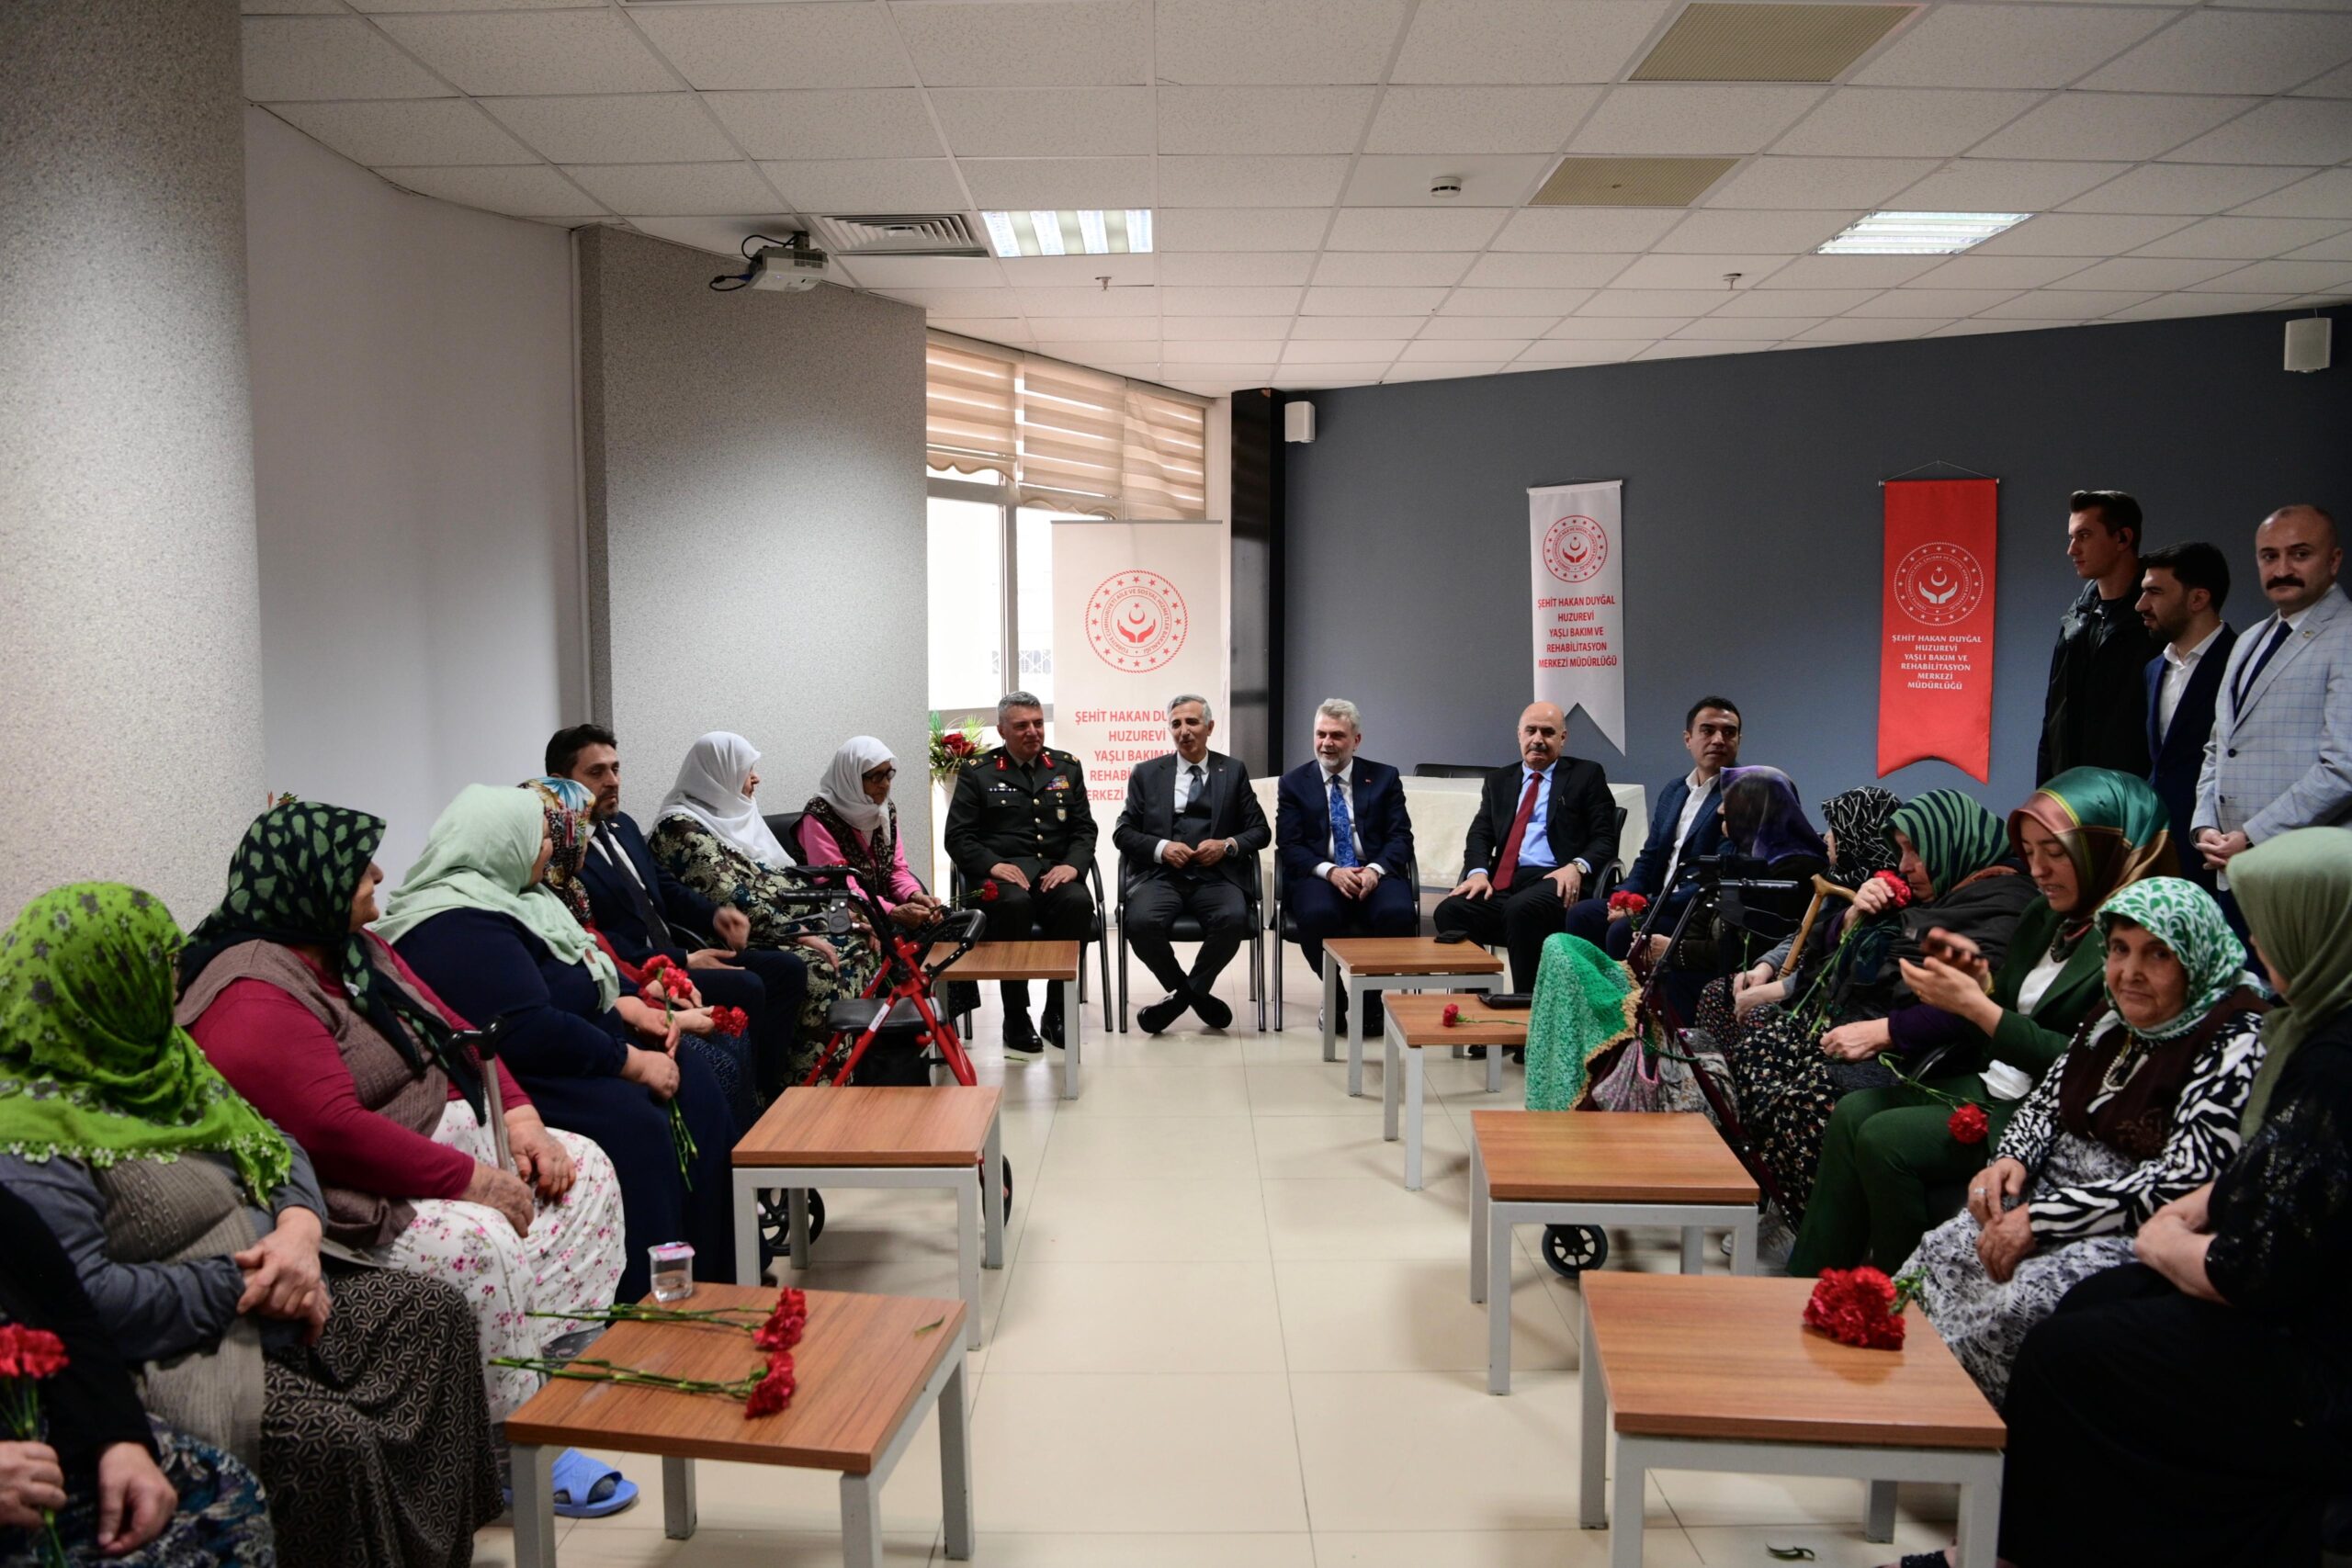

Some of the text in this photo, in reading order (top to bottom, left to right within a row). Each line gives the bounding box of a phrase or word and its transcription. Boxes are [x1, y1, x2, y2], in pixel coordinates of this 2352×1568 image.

[1538, 594, 1615, 609] ŞEHİT HAKAN DUYĞAL
[1558, 610, 1594, 622] HUZUREVİ
[1549, 626, 1604, 639] YAŞLI BAKIM VE
[1892, 634, 1916, 643] ŞEHİT
[1949, 635, 1982, 643] DUYĞAL
[1546, 641, 1607, 653] REHABİLİTASYON
[1915, 644, 1958, 652] HUZUREVİ
[1539, 655, 1617, 668] MERKEZİ MÜDÜRLÜĞÜ
[1904, 653, 1927, 662] YAŞLI
[1901, 661, 1971, 671] REHABİLİTASYON
[1917, 671, 1953, 680] MERKEZİ
[1907, 681, 1962, 690] MÜDÜRLÜĞÜ
[1075, 708, 1107, 724] ŞEHİT
[1110, 710, 1150, 722] HAKAN
[1109, 728, 1166, 741] HUZUREVİ
[1094, 750, 1125, 764] YAŞLI
[1086, 787, 1124, 801] ERKEZİ
